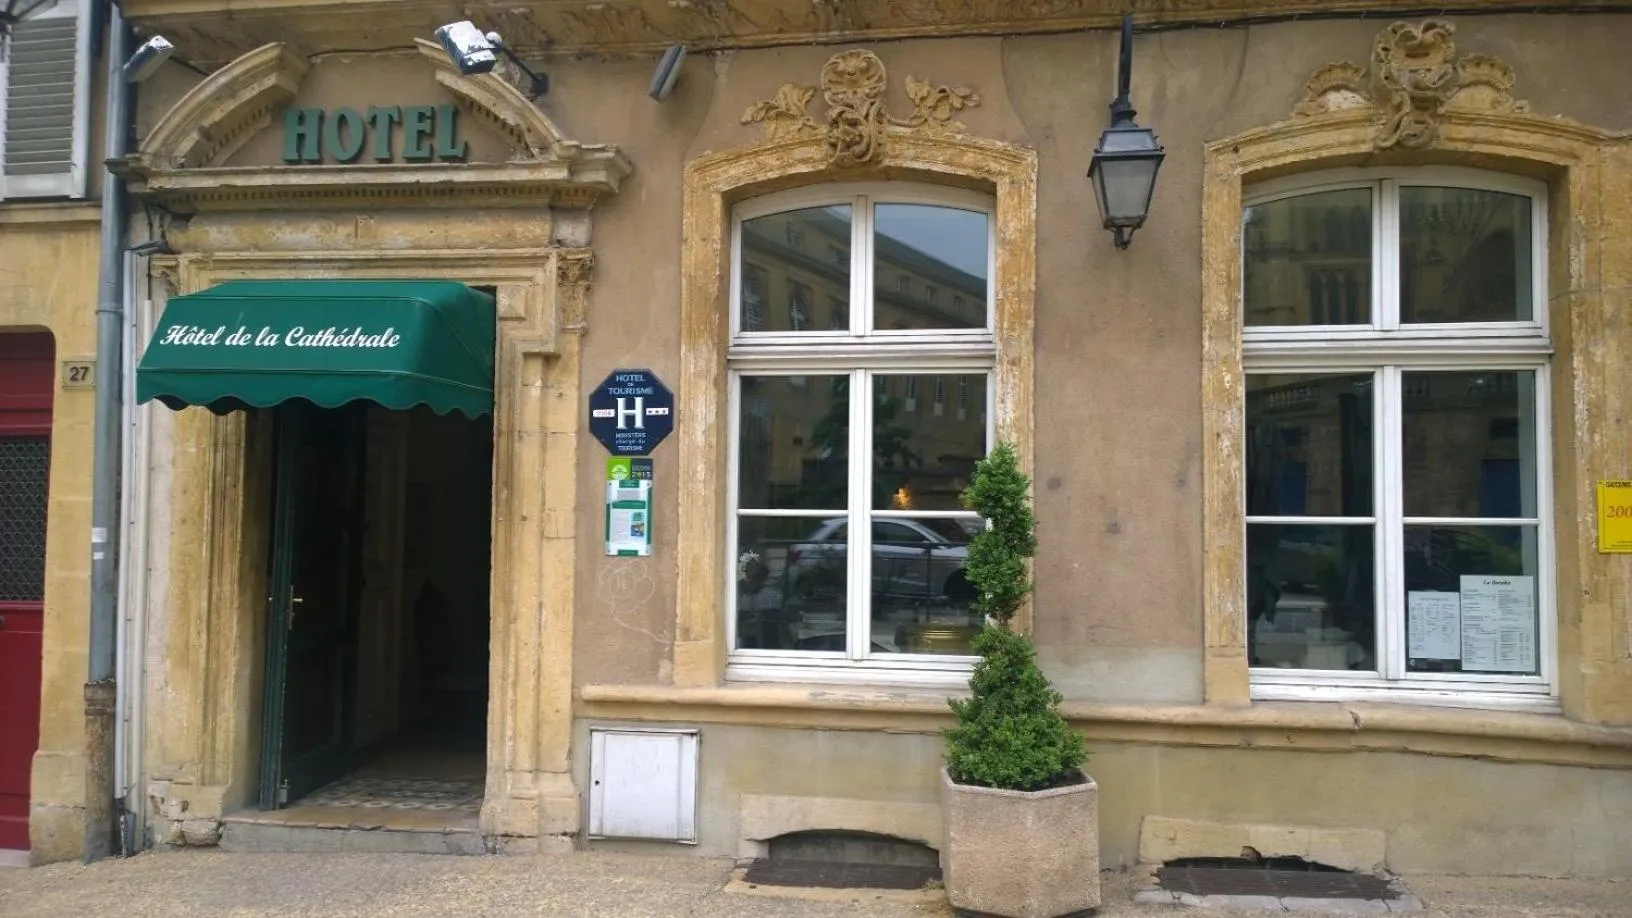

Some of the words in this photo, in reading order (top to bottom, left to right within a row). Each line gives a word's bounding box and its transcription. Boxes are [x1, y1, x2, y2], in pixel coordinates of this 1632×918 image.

[284, 105, 468, 163] HOTEL
[160, 325, 226, 346] Hôtel
[225, 325, 251, 346] de
[255, 326, 280, 347] la
[285, 326, 400, 348] Cathédrale
[70, 366, 89, 381] 27
[616, 374, 646, 382] HOTEL
[608, 387, 654, 395] TOURISME
[616, 396, 645, 430] H
